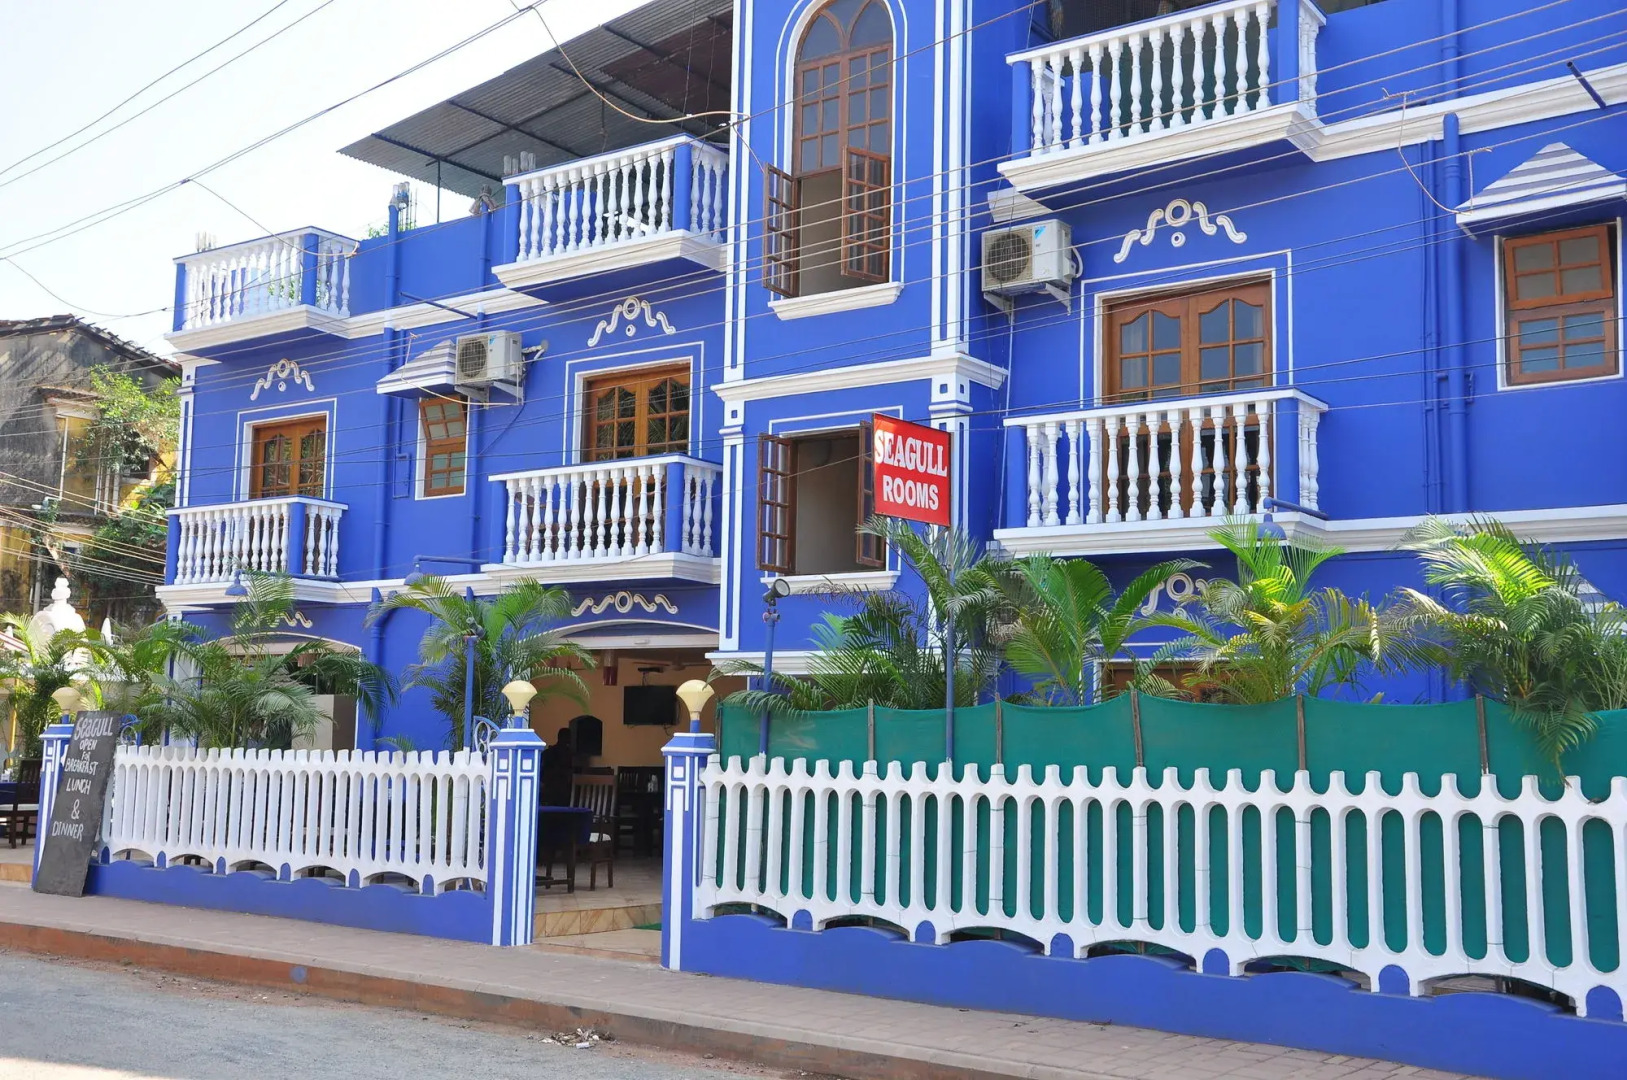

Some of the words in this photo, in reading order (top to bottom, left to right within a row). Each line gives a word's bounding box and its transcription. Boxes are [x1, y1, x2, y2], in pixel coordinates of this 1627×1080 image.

[874, 429, 947, 477] SEAGULL
[883, 475, 939, 510] ROOMS
[80, 738, 98, 751] OPEN
[64, 757, 98, 776] BREAKFAST
[66, 777, 92, 795] LUNCH
[71, 798, 80, 820] &
[52, 820, 84, 842] DINNER
